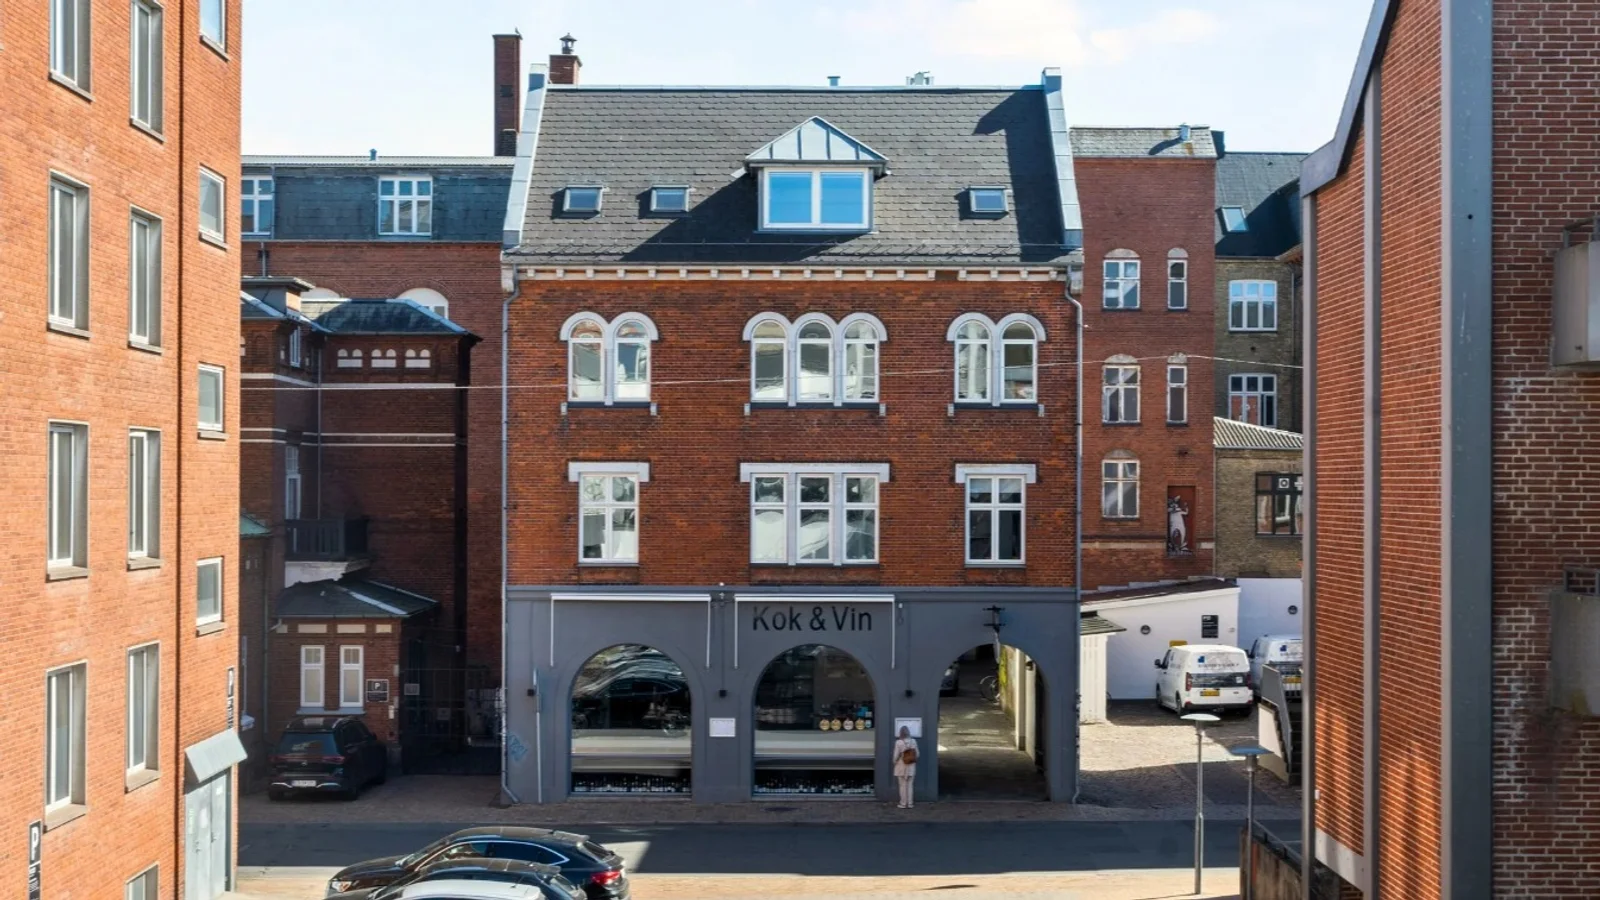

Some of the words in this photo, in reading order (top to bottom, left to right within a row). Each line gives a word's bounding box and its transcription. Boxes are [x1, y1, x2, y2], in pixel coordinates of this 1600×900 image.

[753, 606, 802, 631] Kok
[809, 606, 826, 631] &
[831, 605, 872, 631] Vin
[374, 682, 381, 690] P
[31, 826, 39, 861] P
